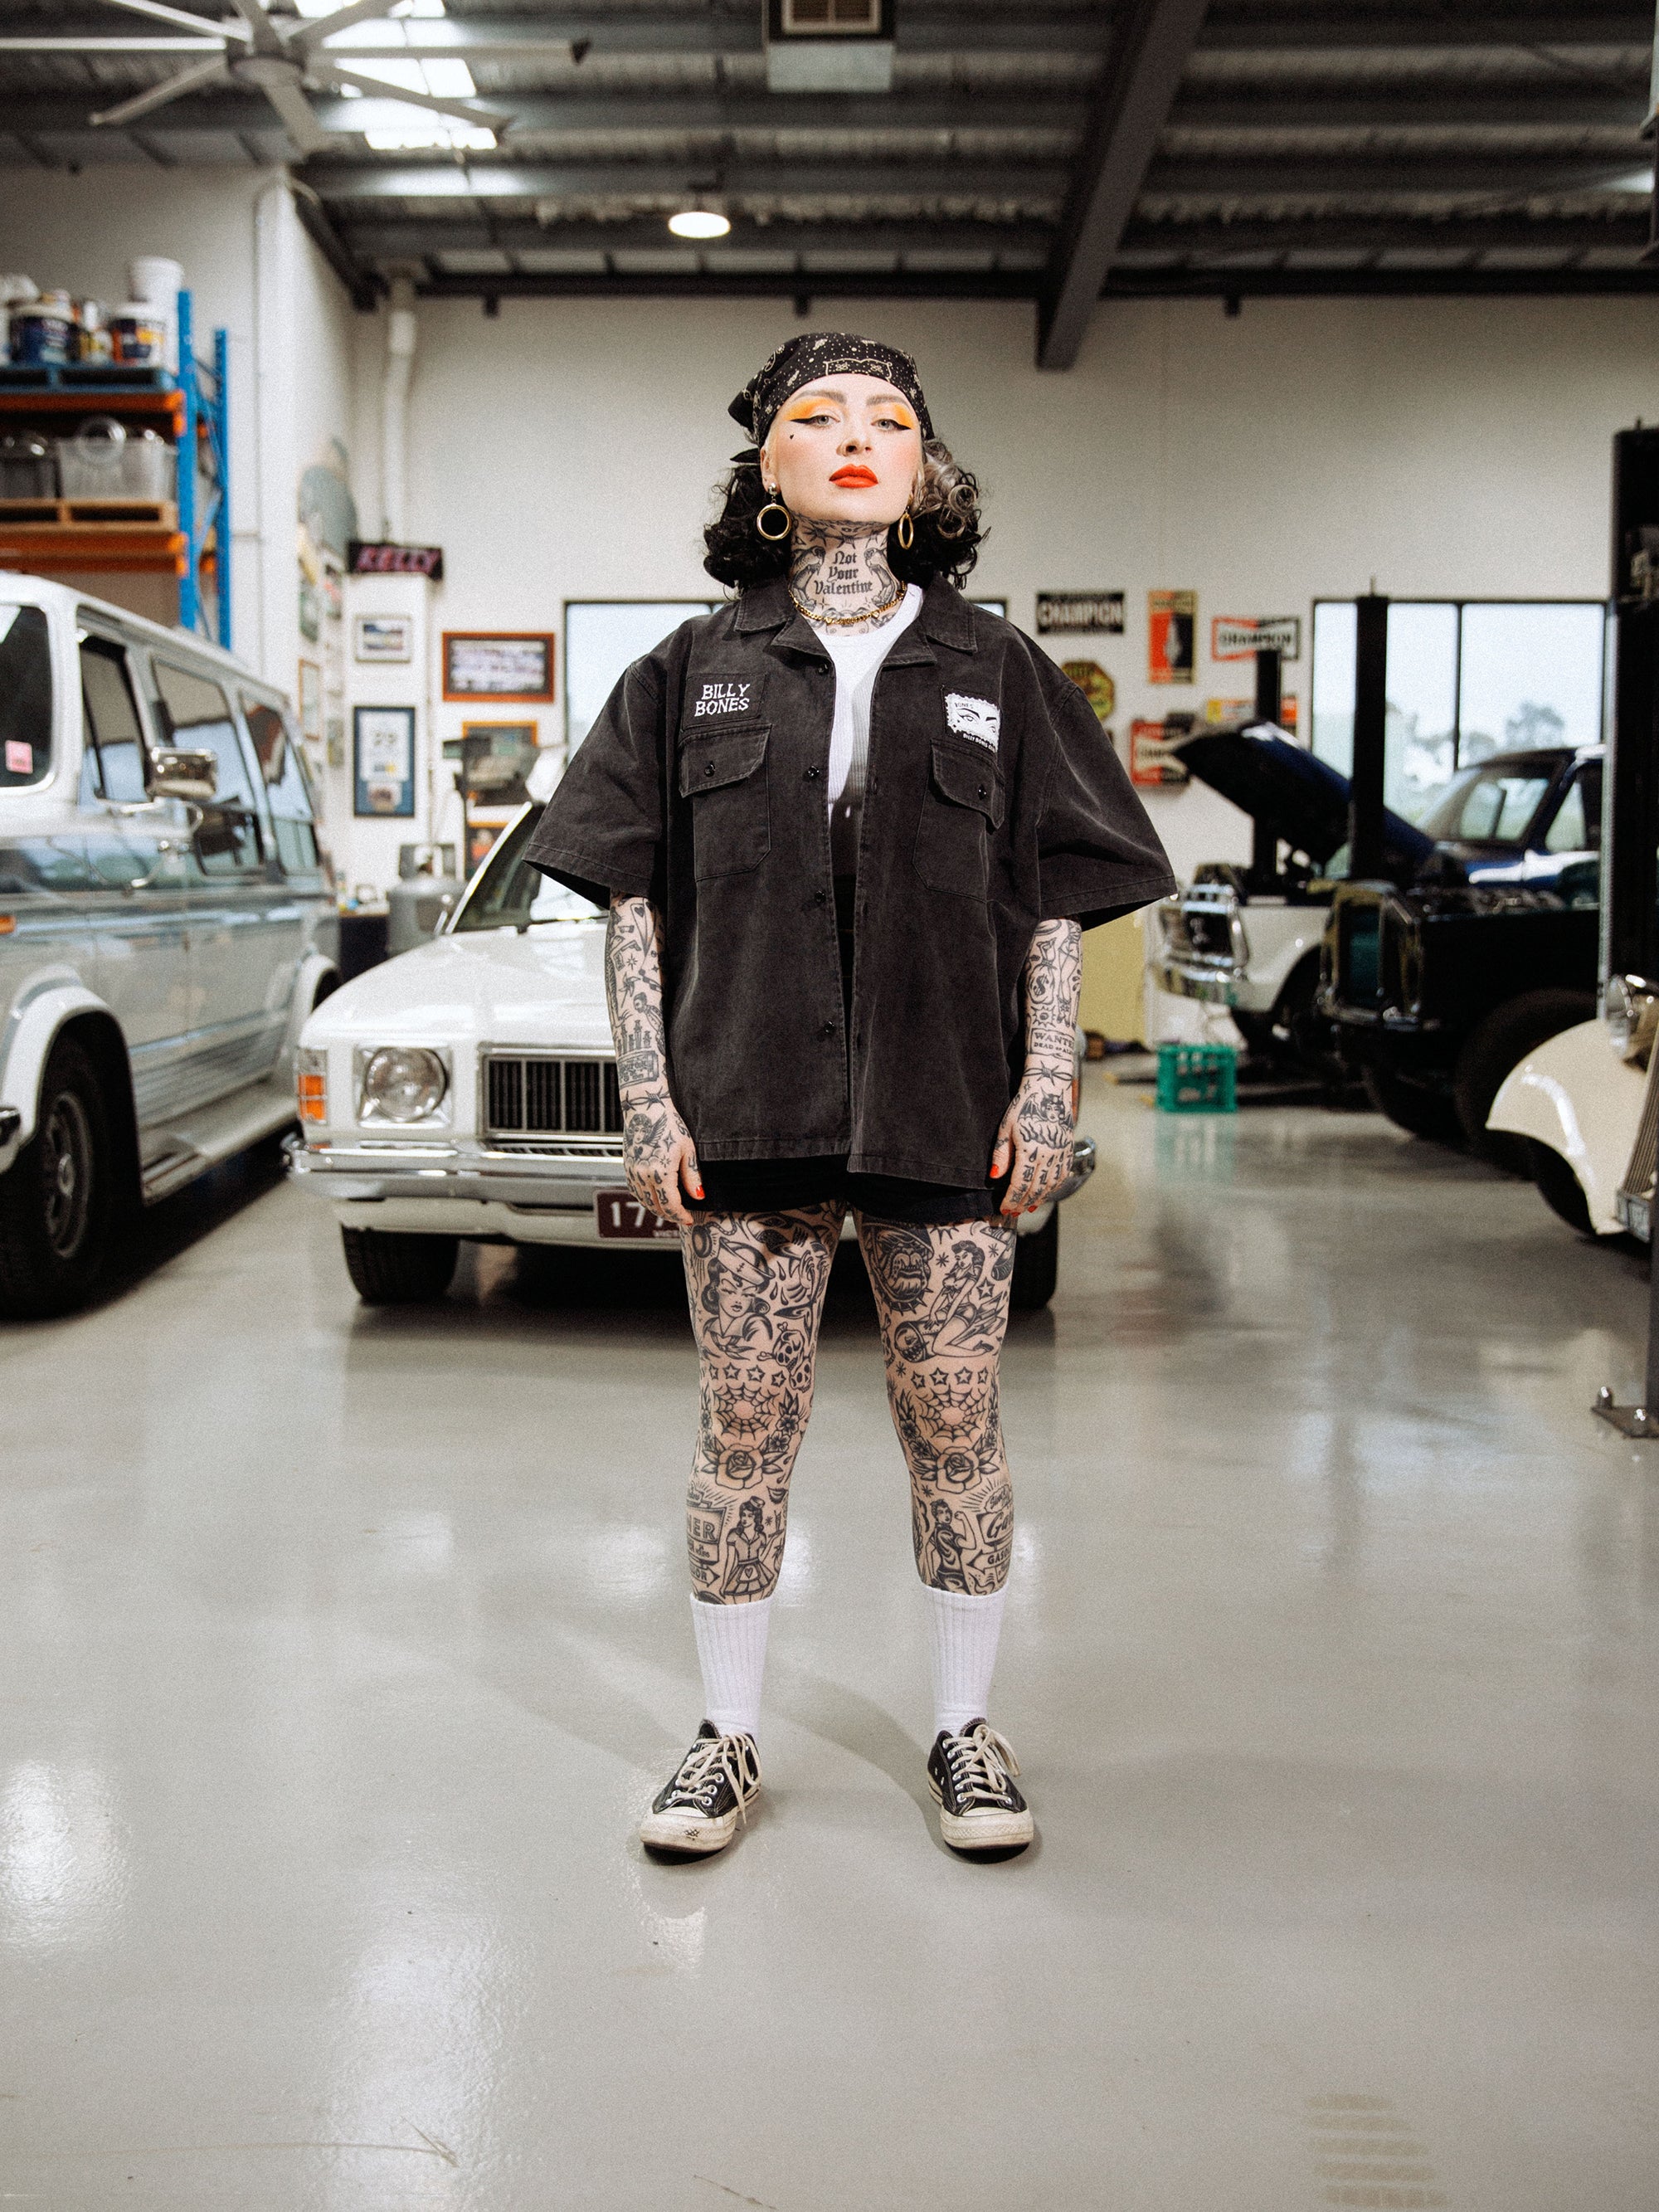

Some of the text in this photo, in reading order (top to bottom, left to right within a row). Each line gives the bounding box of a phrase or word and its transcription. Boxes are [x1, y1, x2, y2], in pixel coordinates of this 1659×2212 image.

[832, 550, 858, 565] Not
[826, 566, 859, 582] Your
[813, 579, 873, 596] Valentine
[1037, 602, 1124, 626] CHAMPION
[1219, 633, 1292, 647] CHAMPION
[701, 683, 751, 700] BILLY
[694, 697, 750, 717] BONES
[1034, 1031, 1075, 1049] WANTE
